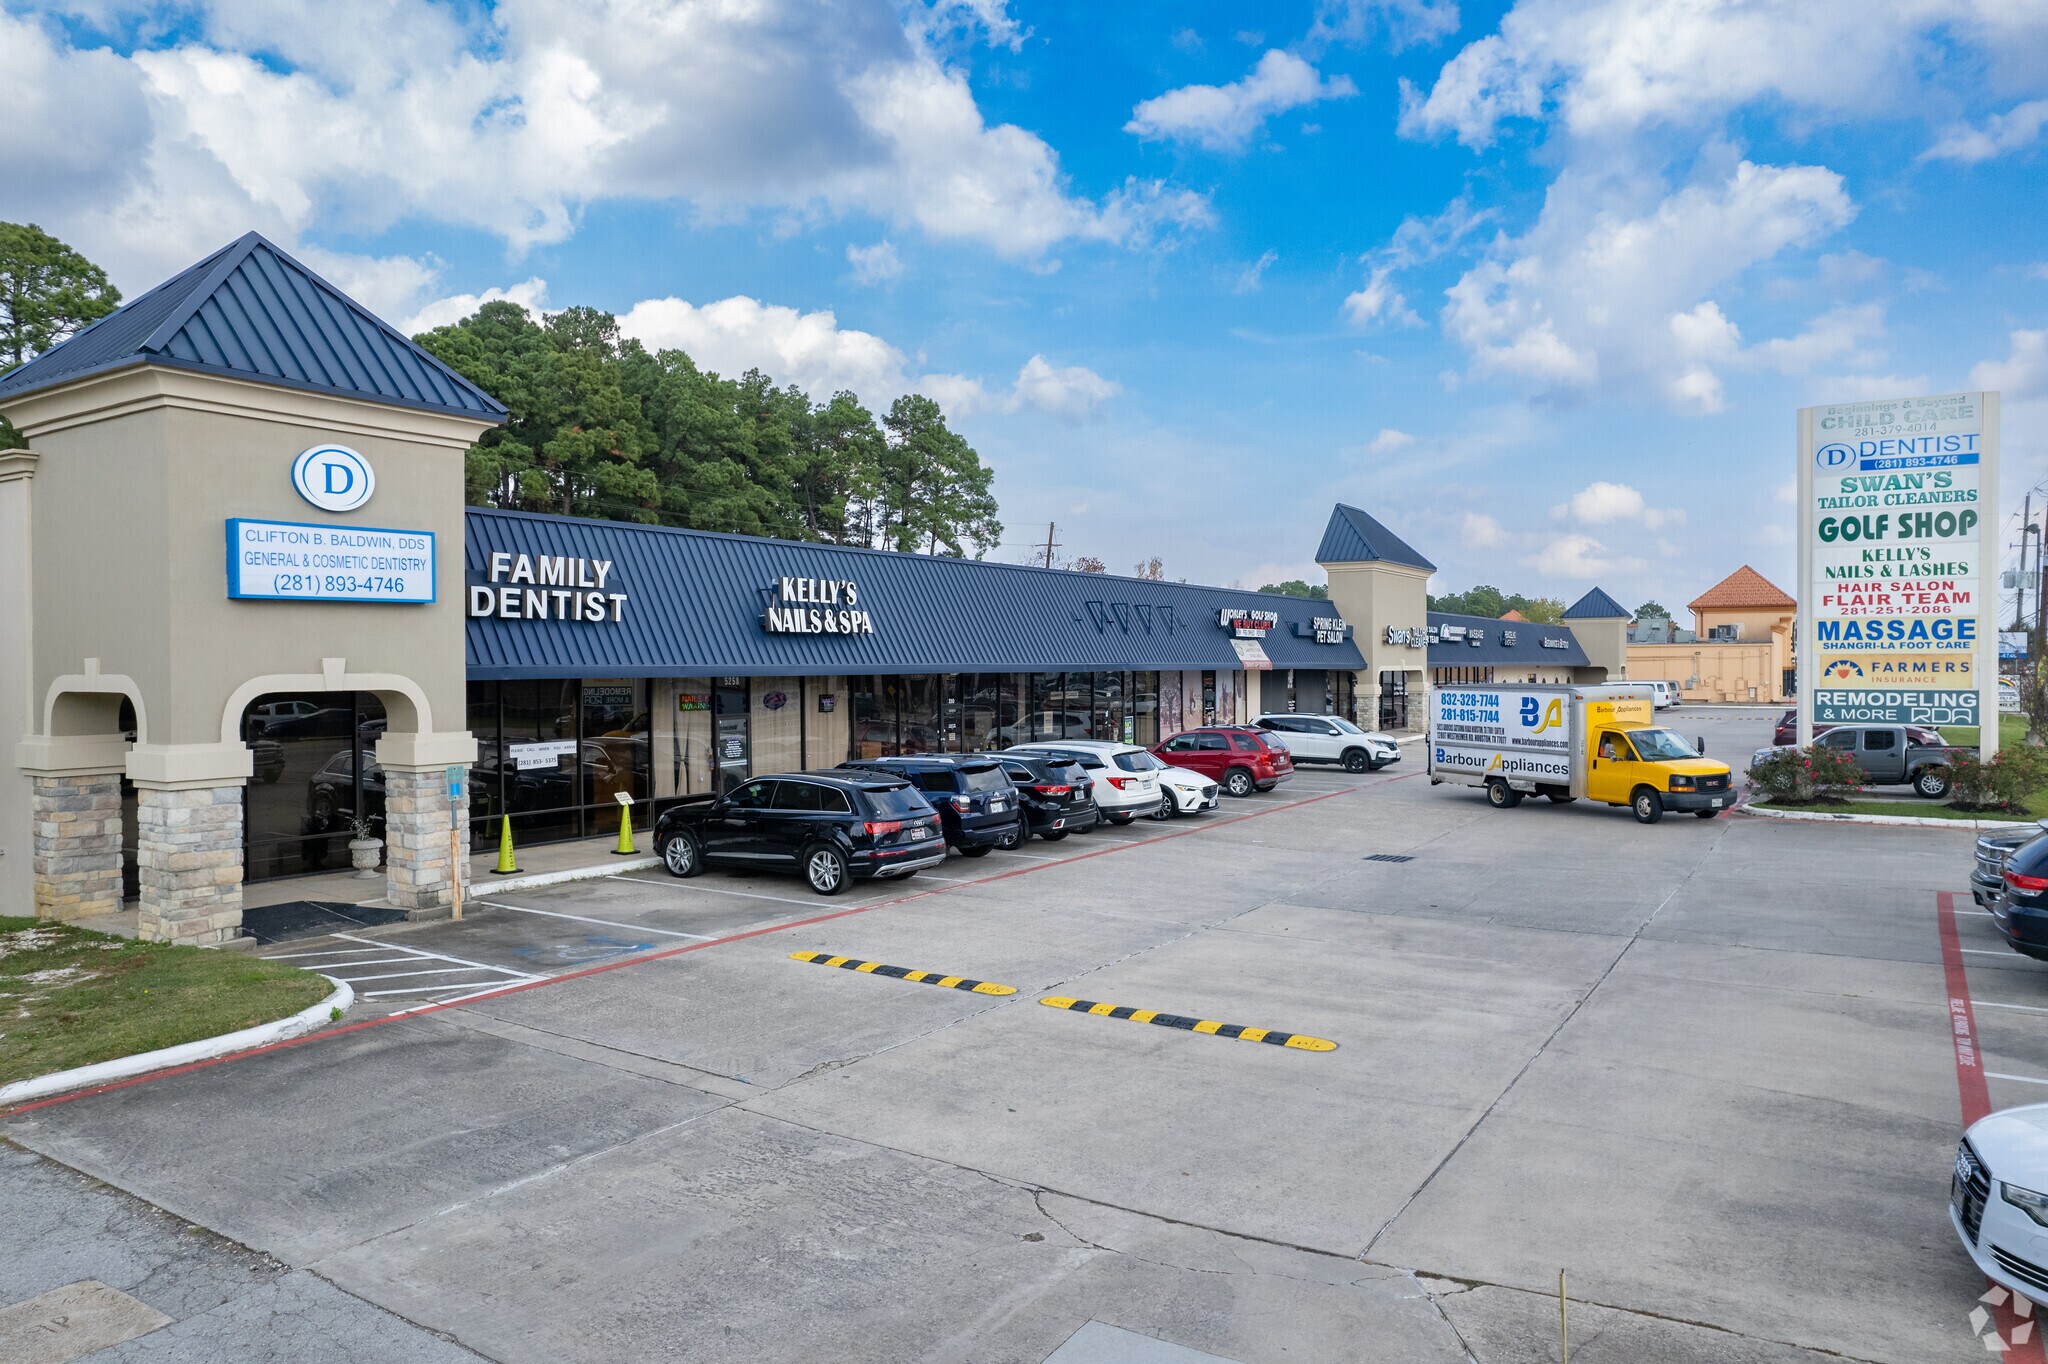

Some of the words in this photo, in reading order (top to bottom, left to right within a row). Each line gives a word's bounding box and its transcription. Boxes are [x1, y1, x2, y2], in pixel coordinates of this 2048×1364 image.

[1902, 400, 1912, 409] &
[1820, 412, 1895, 430] CHILD
[1904, 405, 1974, 424] CARE
[1854, 422, 1937, 437] 281-379-4014
[1860, 434, 1980, 458] DENTIST
[1828, 449, 1846, 466] D
[1874, 458, 1902, 470] (281)
[1905, 456, 1958, 468] 893-4746
[322, 462, 354, 494] D
[1840, 470, 1952, 494] SWAN'S
[1818, 495, 1879, 510] TAILOR
[1884, 488, 1978, 506] CLEANERS
[1818, 514, 1888, 543] GOLF
[1898, 509, 1978, 539] SHOP
[245, 530, 309, 545] CLIFTON
[314, 534, 326, 546] B.
[330, 535, 395, 550] BALDWIN,
[399, 538, 425, 550] DDS
[244, 551, 300, 567] GENERAL
[302, 554, 310, 567] &
[312, 554, 369, 570] COSMETIC
[372, 557, 427, 571] DENTISTRY
[1862, 546, 1931, 562] KELLY'S
[489, 552, 612, 588] FAMILY
[1825, 564, 1874, 579] NAILS
[1880, 564, 1892, 578] &
[1900, 562, 1969, 577] LASHES
[274, 574, 321, 595] (281)
[325, 576, 404, 593] 893-4746
[782, 576, 858, 606] KELLY'S
[1838, 582, 1882, 592] HAIR
[1890, 580, 1955, 591] SALON
[469, 586, 628, 622] DENTIST
[1822, 594, 1891, 606] FLAIR
[1902, 592, 1970, 604] TEAM
[1840, 606, 1952, 616] 281-251-2086
[1313, 617, 1332, 630] SPRING
[1818, 618, 1976, 641] MASSAGE
[1316, 630, 1327, 642] PET
[1328, 631, 1344, 644] SALON
[1822, 642, 1895, 650] SHANGRI-LA
[1872, 662, 1970, 673] FARMERS
[724, 676, 740, 686] 5258
[1441, 693, 1499, 707] 832-328-7744
[1816, 692, 1977, 707] REMODELING
[1441, 708, 1499, 723] 281-815-7744
[1823, 709, 1835, 720] &
[1841, 709, 1898, 720] MORE
[1436, 748, 1487, 767] Barbour
[1488, 753, 1569, 775] Appliances
